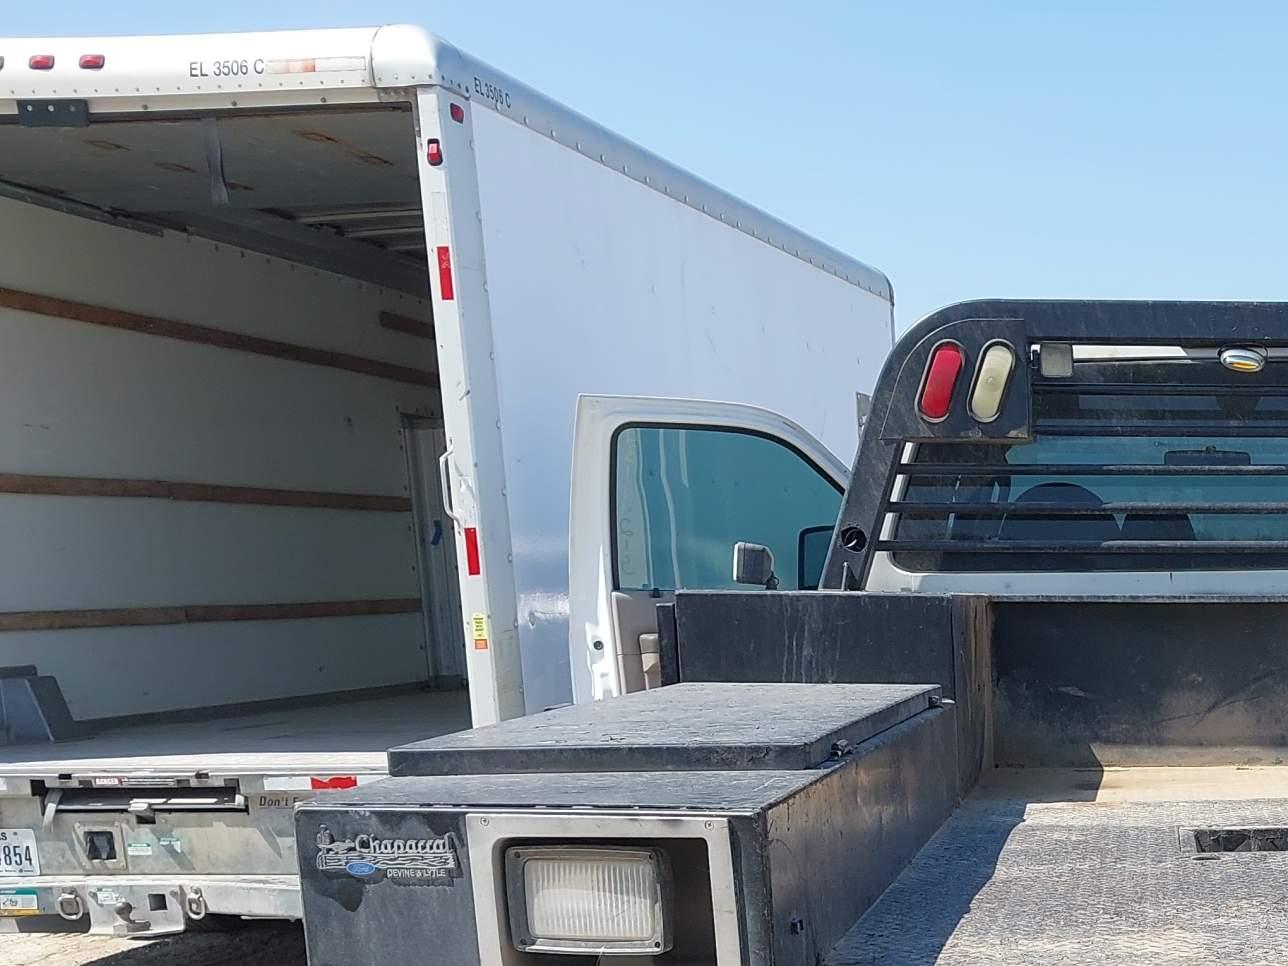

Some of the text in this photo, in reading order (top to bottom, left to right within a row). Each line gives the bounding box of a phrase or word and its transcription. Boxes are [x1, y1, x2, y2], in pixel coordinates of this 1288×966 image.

[189, 58, 265, 77] EL 3506 C
[474, 76, 484, 97] EL
[259, 795, 289, 807] Don't
[355, 832, 455, 856] Chaparral
[0, 845, 33, 867] 854
[386, 868, 415, 878] DEVINE
